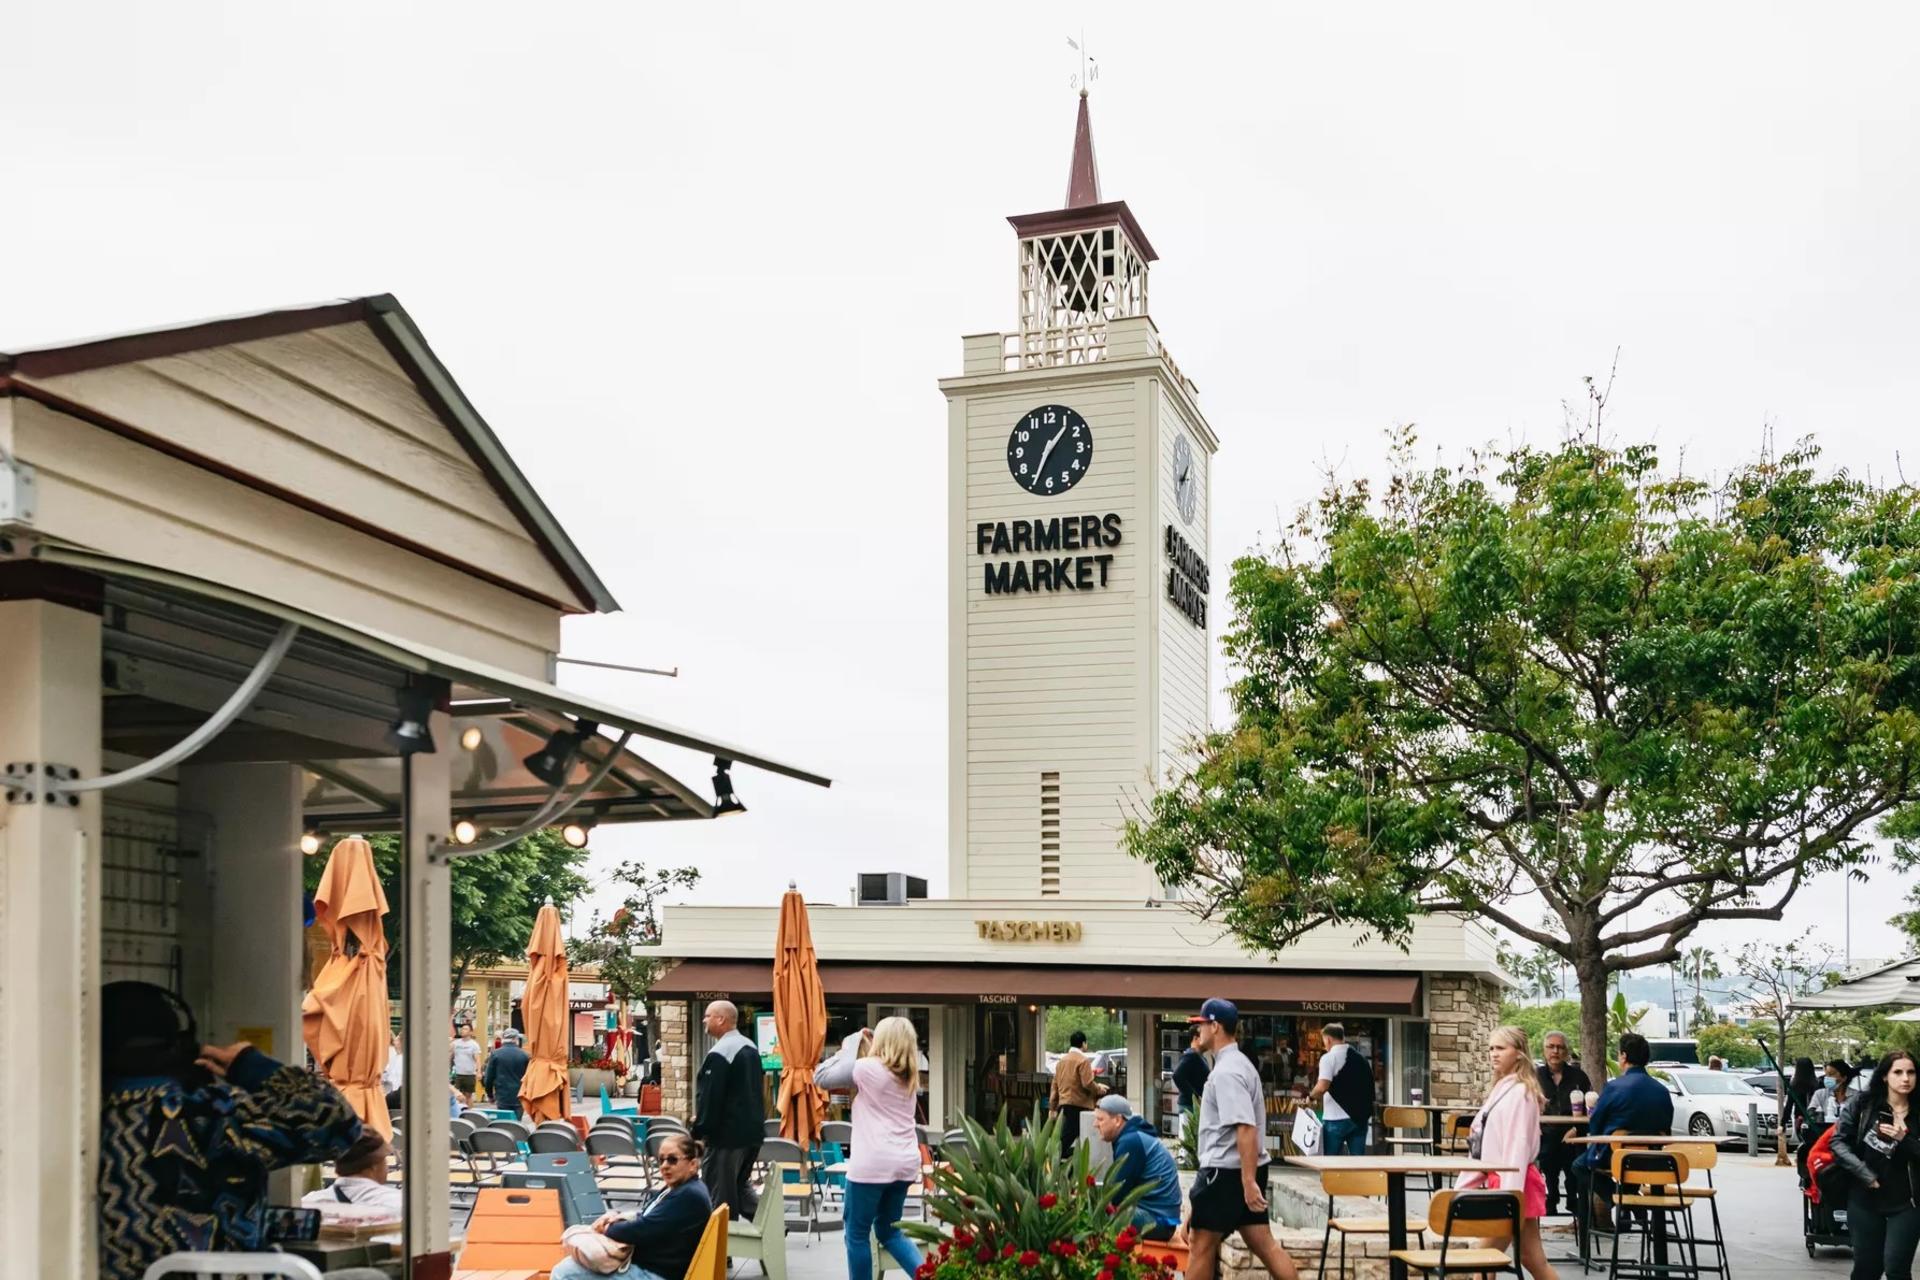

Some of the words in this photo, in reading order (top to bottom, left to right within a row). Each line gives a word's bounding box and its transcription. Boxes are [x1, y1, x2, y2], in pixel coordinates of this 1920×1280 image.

[1030, 417, 1039, 430] 11
[1043, 412, 1056, 424] 12
[1062, 415, 1067, 427] 1
[1018, 430, 1030, 443] 10
[1072, 426, 1080, 438] 2
[1015, 447, 1024, 459] 9
[1076, 441, 1084, 453] 3
[1019, 463, 1028, 474] 8
[1071, 459, 1080, 471] 4
[1045, 476, 1054, 488] 6
[1061, 471, 1070, 483] 5
[976, 513, 1122, 555] FARMERS
[984, 554, 1114, 594] MARKET
[974, 920, 1082, 943] TASCHEN
[696, 991, 730, 1000] TASCHEN
[979, 994, 1018, 1004] TASCHEN
[569, 1001, 593, 1009] TAND
[1302, 1001, 1345, 1012] TASCHEN
